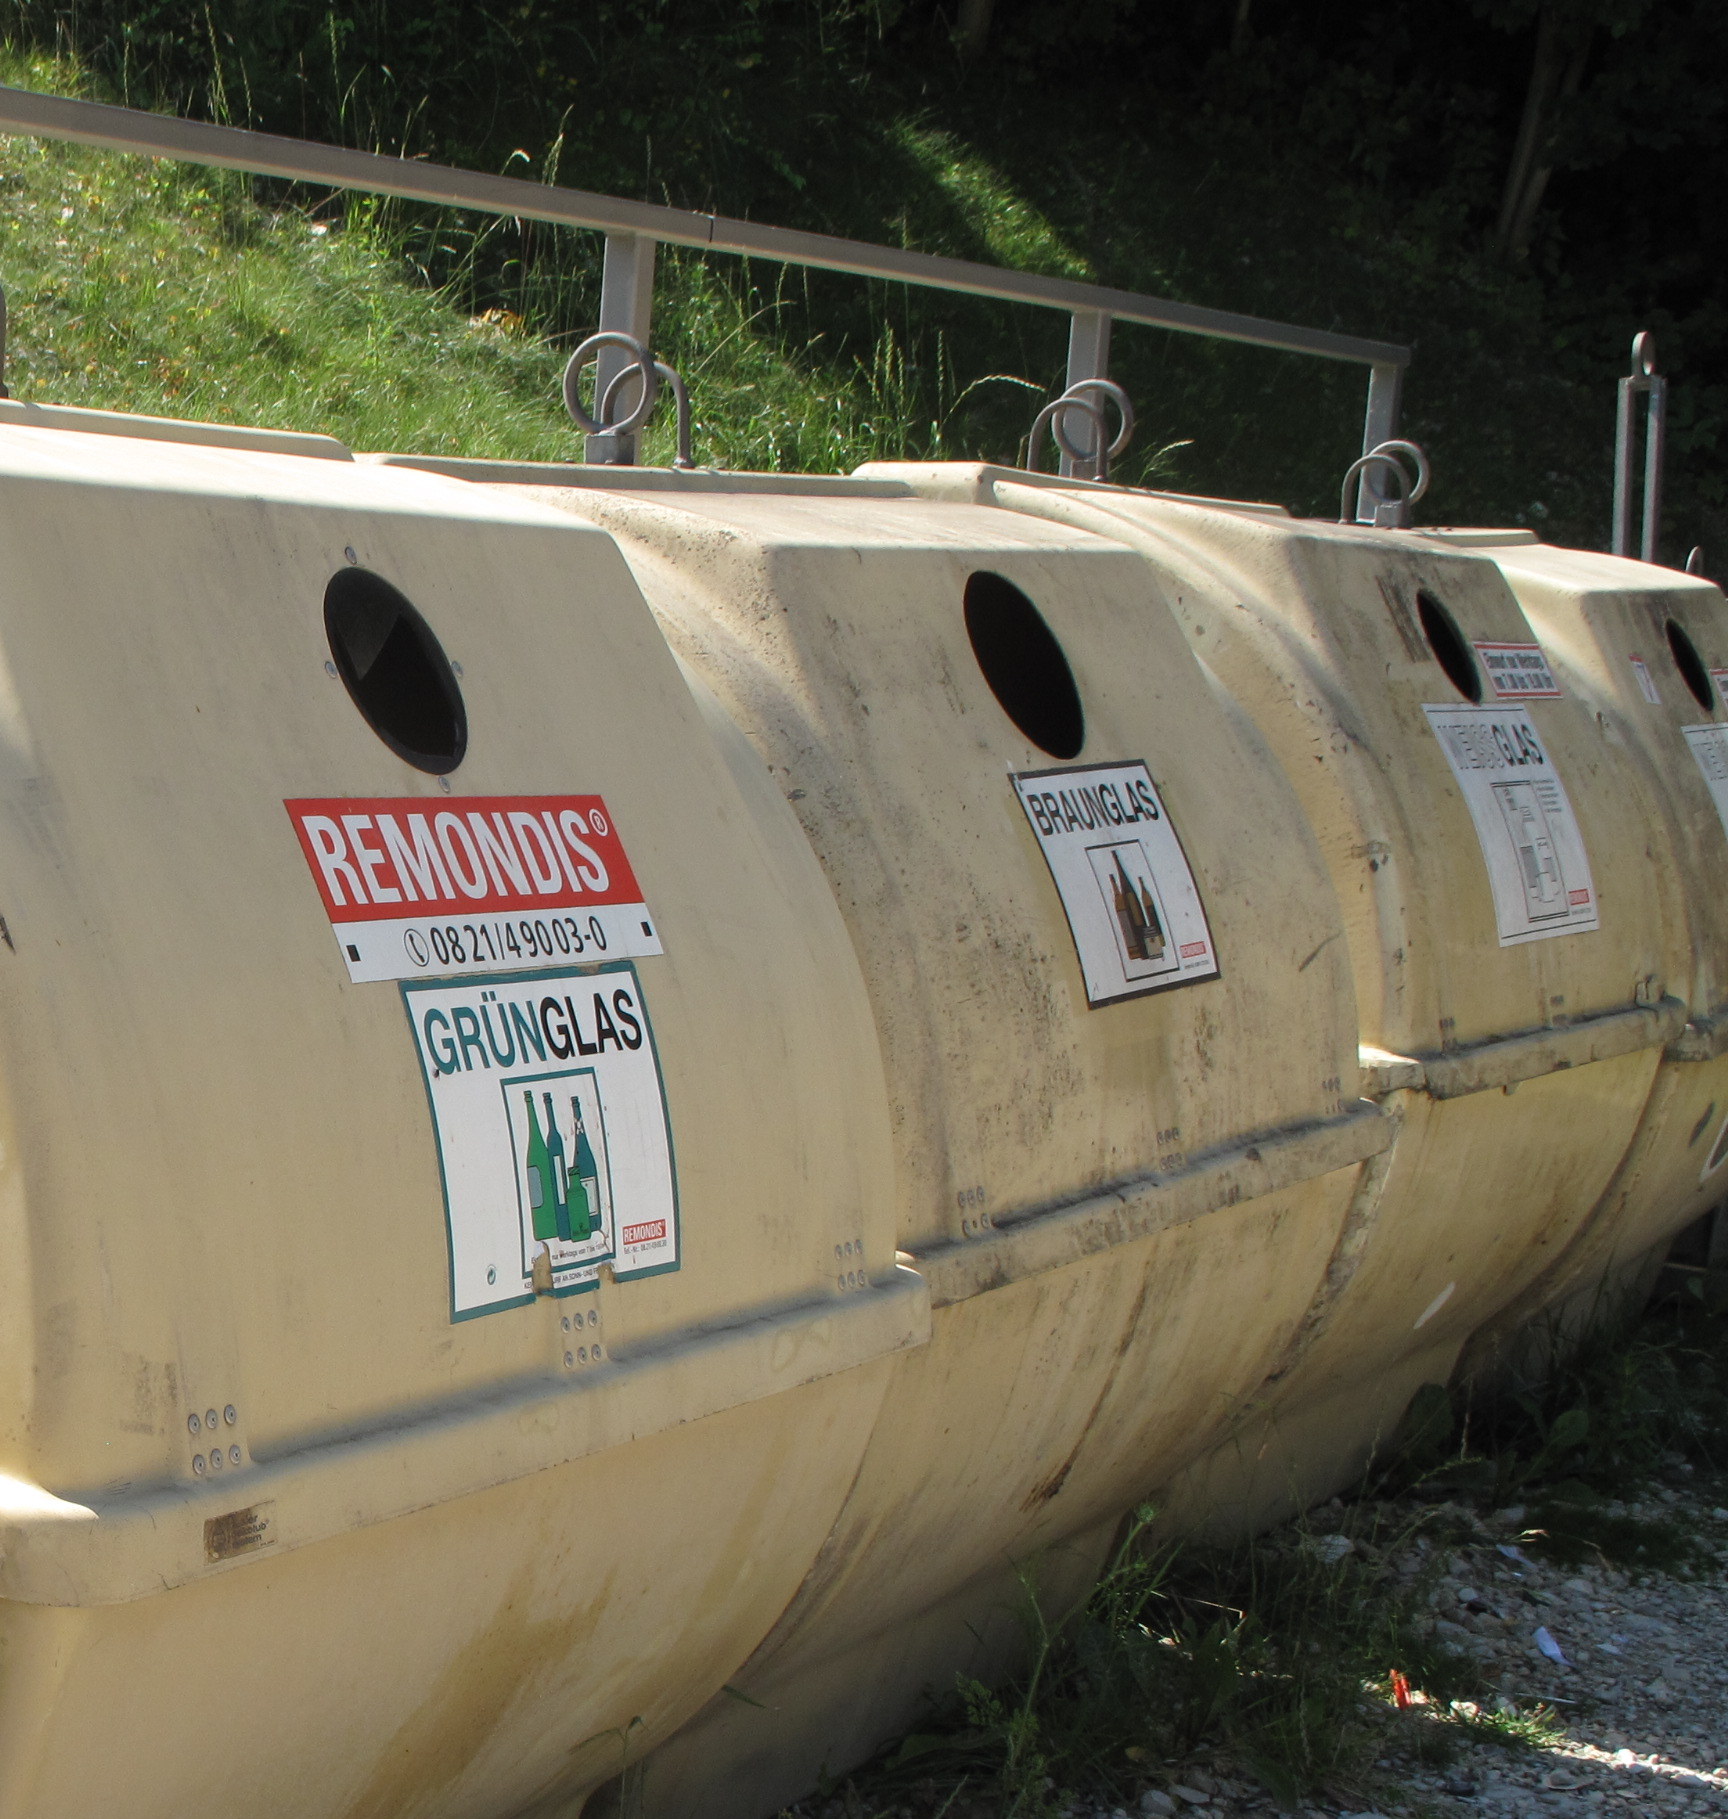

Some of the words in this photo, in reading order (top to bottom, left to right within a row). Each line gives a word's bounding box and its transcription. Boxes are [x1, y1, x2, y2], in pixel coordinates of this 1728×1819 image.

[1026, 779, 1160, 836] BRAUNGLAS
[429, 915, 608, 966] 0821/49003-0
[422, 988, 643, 1075] GRÜNGLAS
